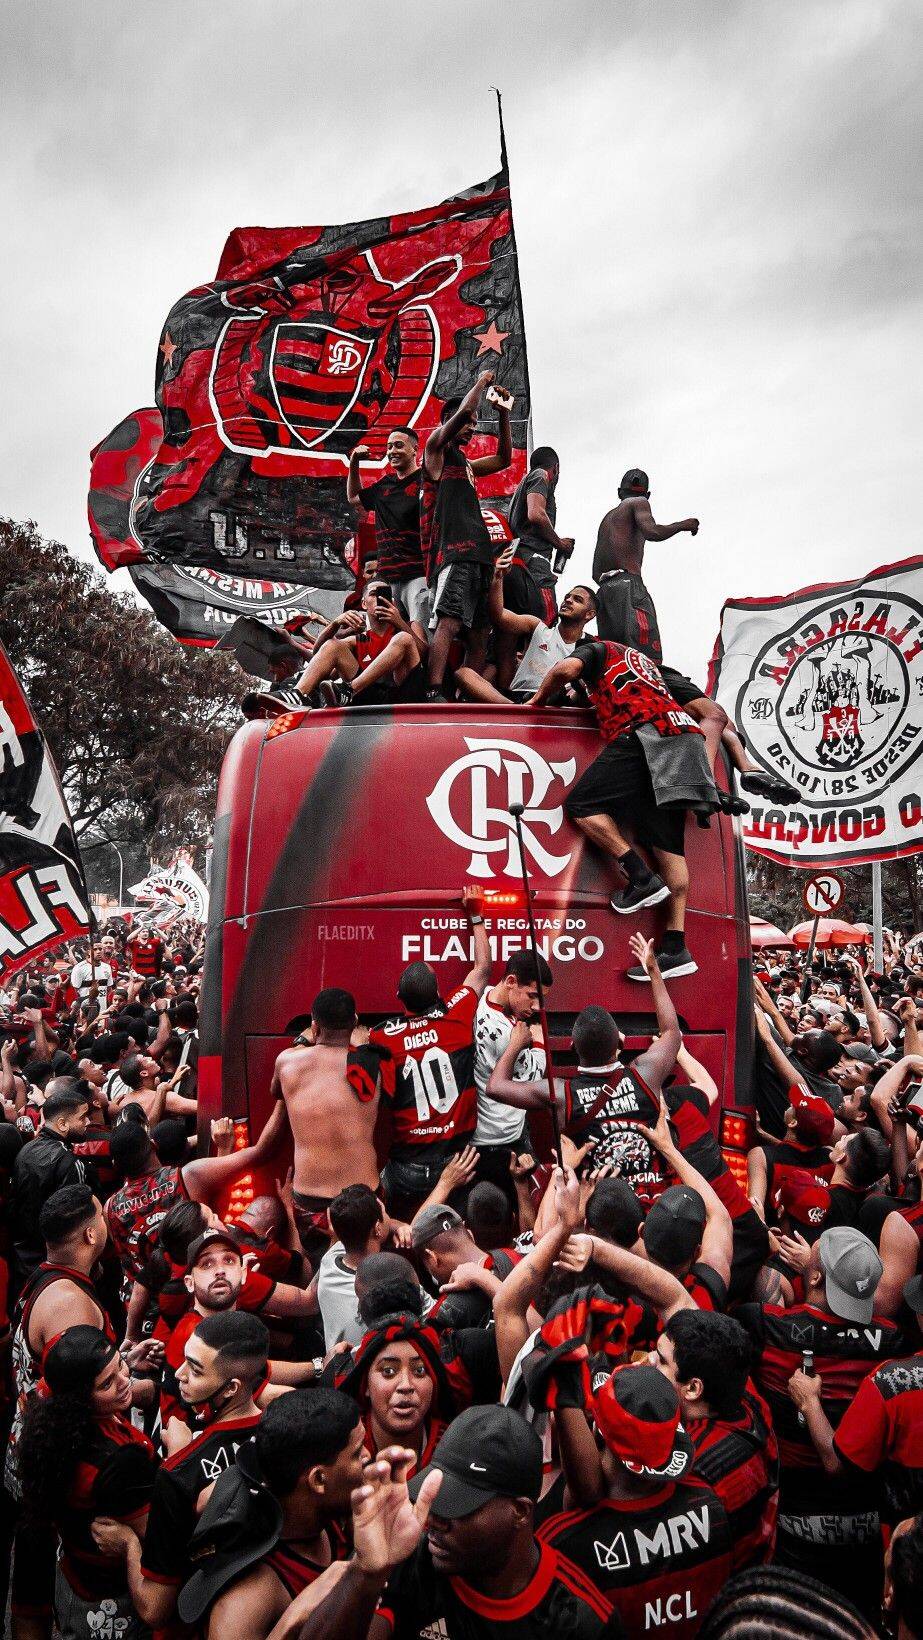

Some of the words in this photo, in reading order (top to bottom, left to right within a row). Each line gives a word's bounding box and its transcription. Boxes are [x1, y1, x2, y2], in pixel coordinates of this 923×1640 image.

[420, 918, 468, 930] CLUBE
[497, 918, 561, 930] REGATAS
[565, 918, 587, 930] DO
[403, 1029, 439, 1051] DIEGO
[402, 1046, 460, 1122] 10
[633, 1504, 710, 1566] MRV
